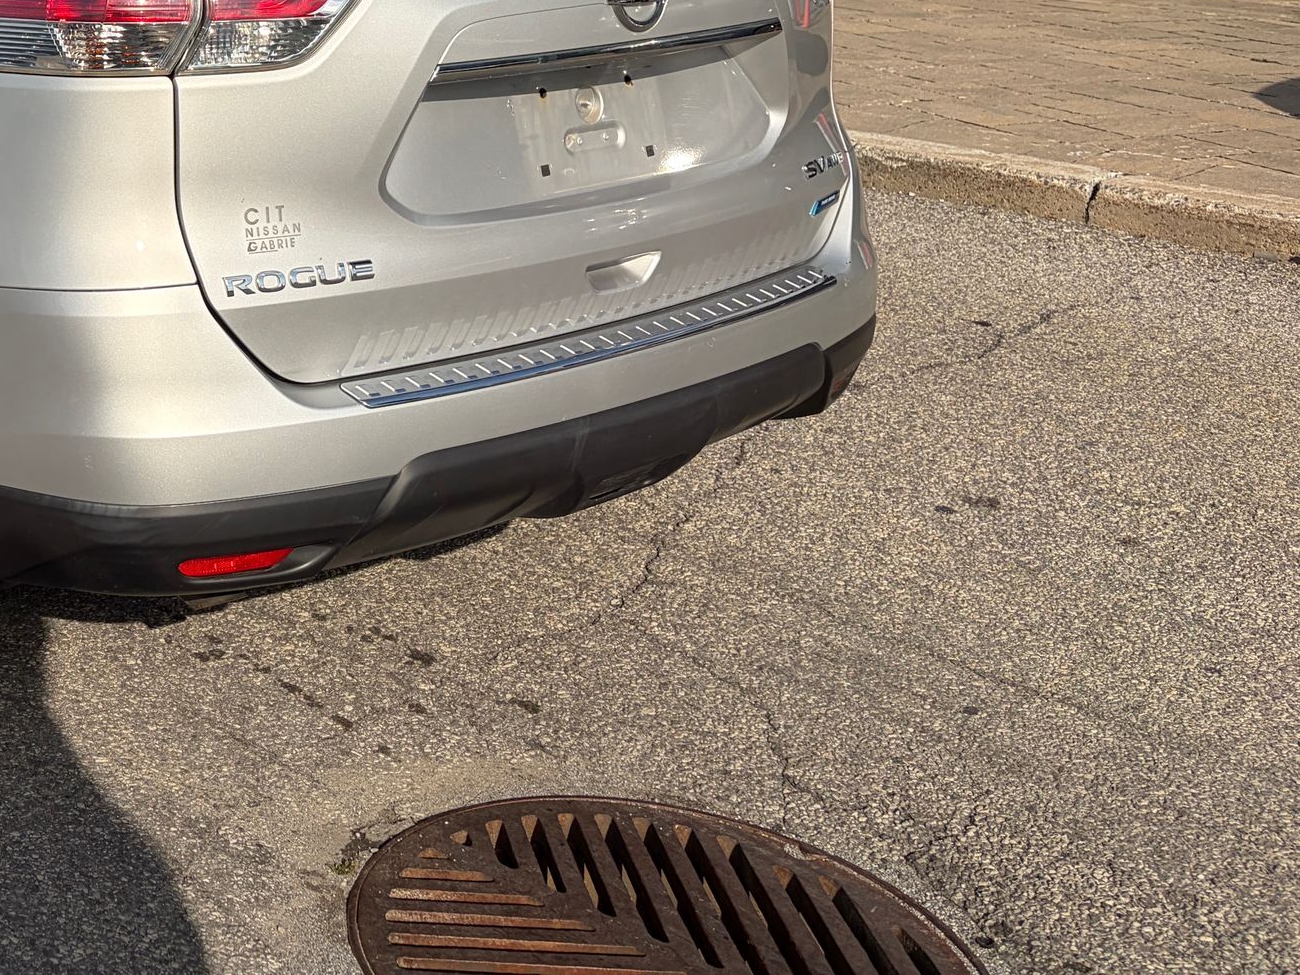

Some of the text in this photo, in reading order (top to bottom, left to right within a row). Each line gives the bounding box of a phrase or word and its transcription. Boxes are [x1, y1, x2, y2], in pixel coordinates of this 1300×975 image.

[243, 205, 285, 225] CIT
[245, 223, 301, 238] NISSAN
[222, 259, 375, 297] ROGUE
